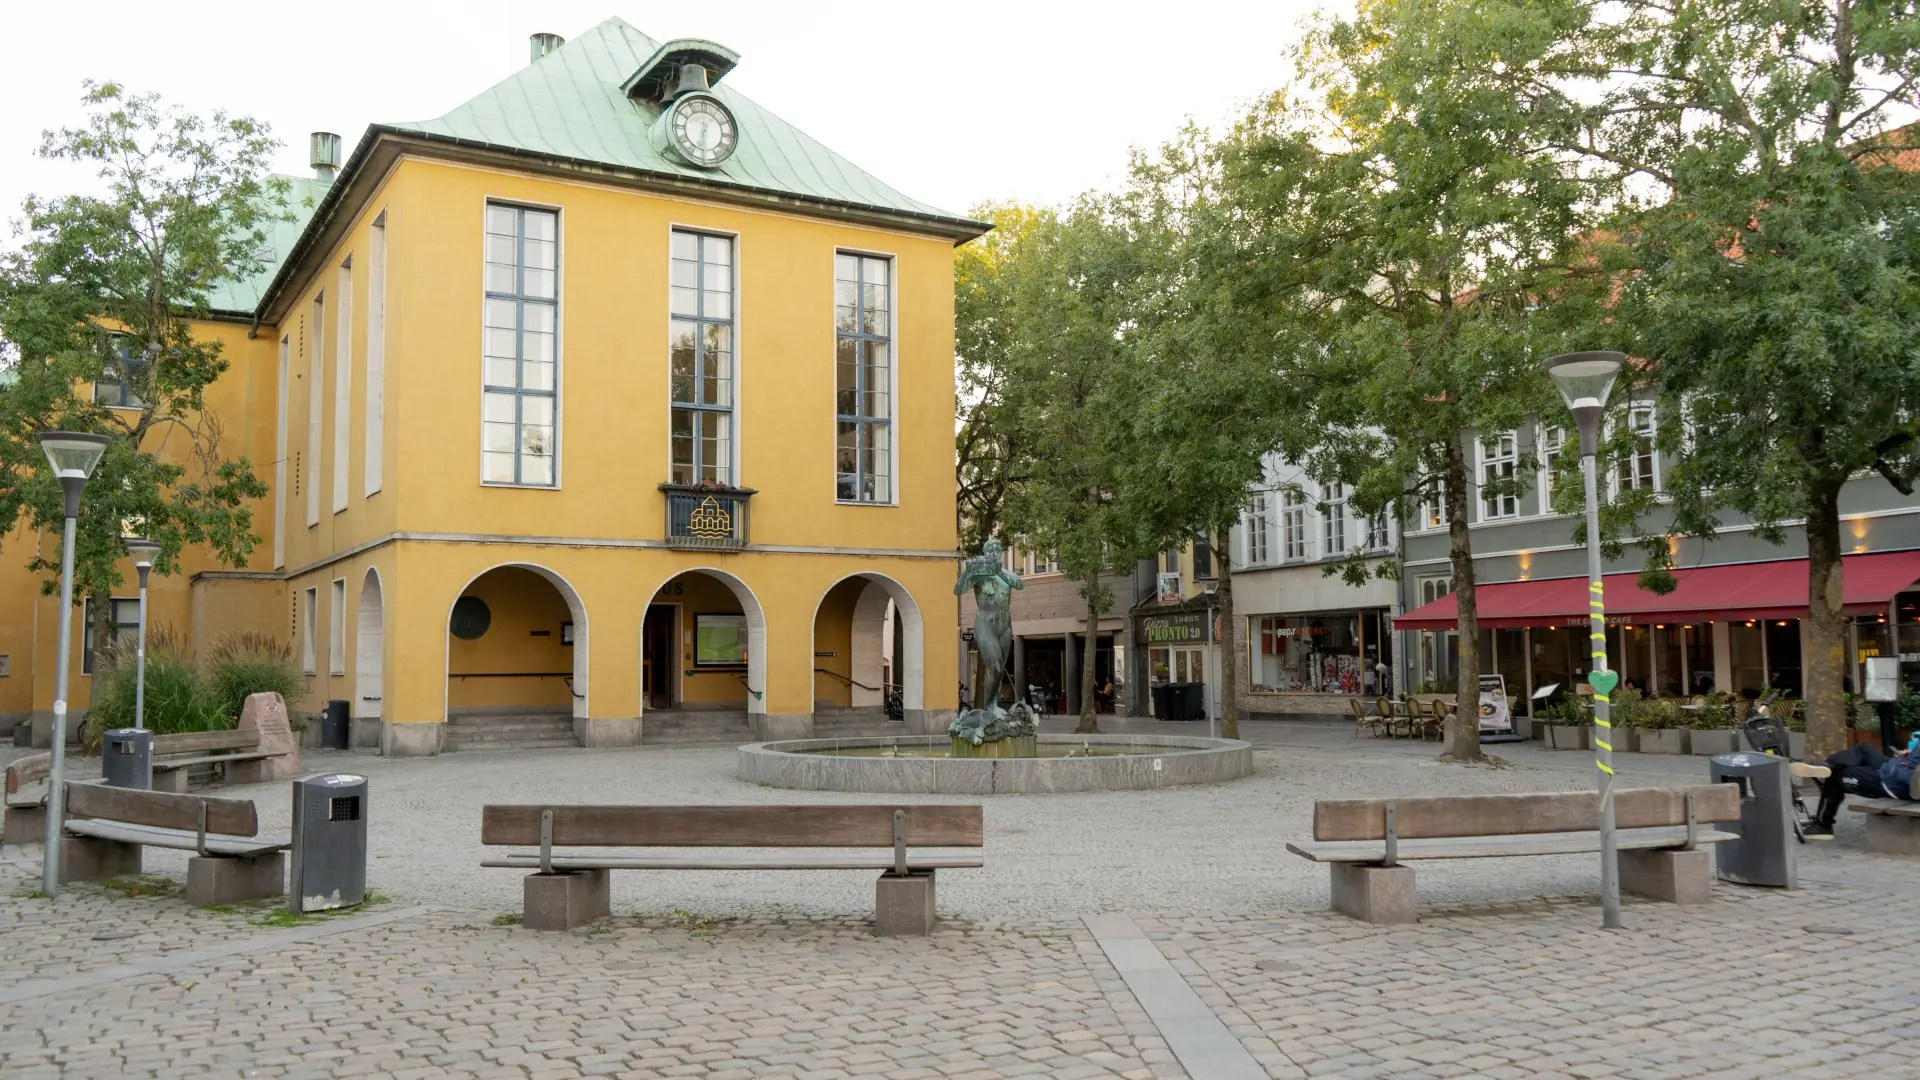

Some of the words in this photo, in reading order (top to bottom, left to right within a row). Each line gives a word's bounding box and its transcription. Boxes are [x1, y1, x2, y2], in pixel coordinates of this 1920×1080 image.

[1143, 617, 1169, 637] Pizza
[1567, 618, 1580, 626] THE
[1612, 615, 1632, 624] CAFÉ
[1148, 625, 1188, 641] PRONTO
